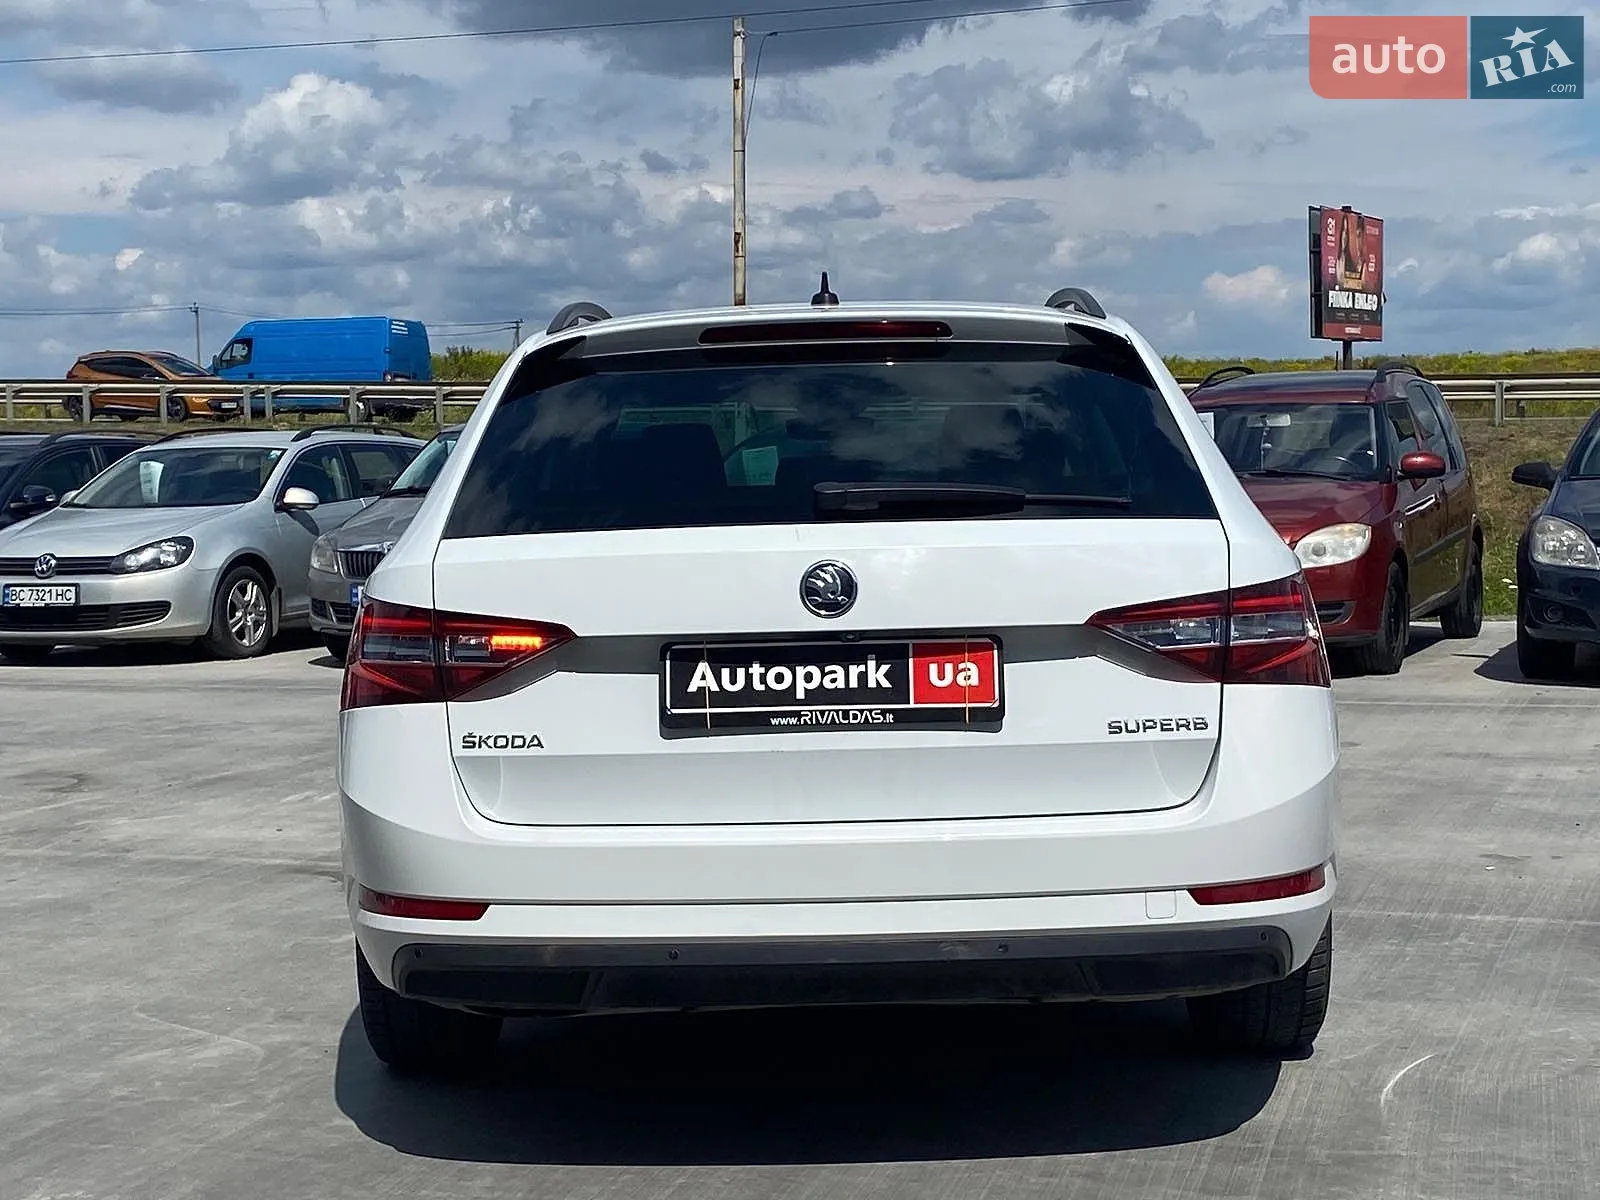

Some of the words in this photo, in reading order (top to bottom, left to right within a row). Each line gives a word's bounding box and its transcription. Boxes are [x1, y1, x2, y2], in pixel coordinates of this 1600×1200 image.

[10, 589, 25, 602] BC
[28, 589, 52, 602] 7321
[55, 588, 72, 602] HC
[687, 654, 892, 700] Autopark
[928, 660, 980, 688] ua
[770, 709, 894, 726] www.RIVALDAS.lt
[1107, 716, 1209, 735] SUPERB
[461, 731, 545, 749] ŠKODA
